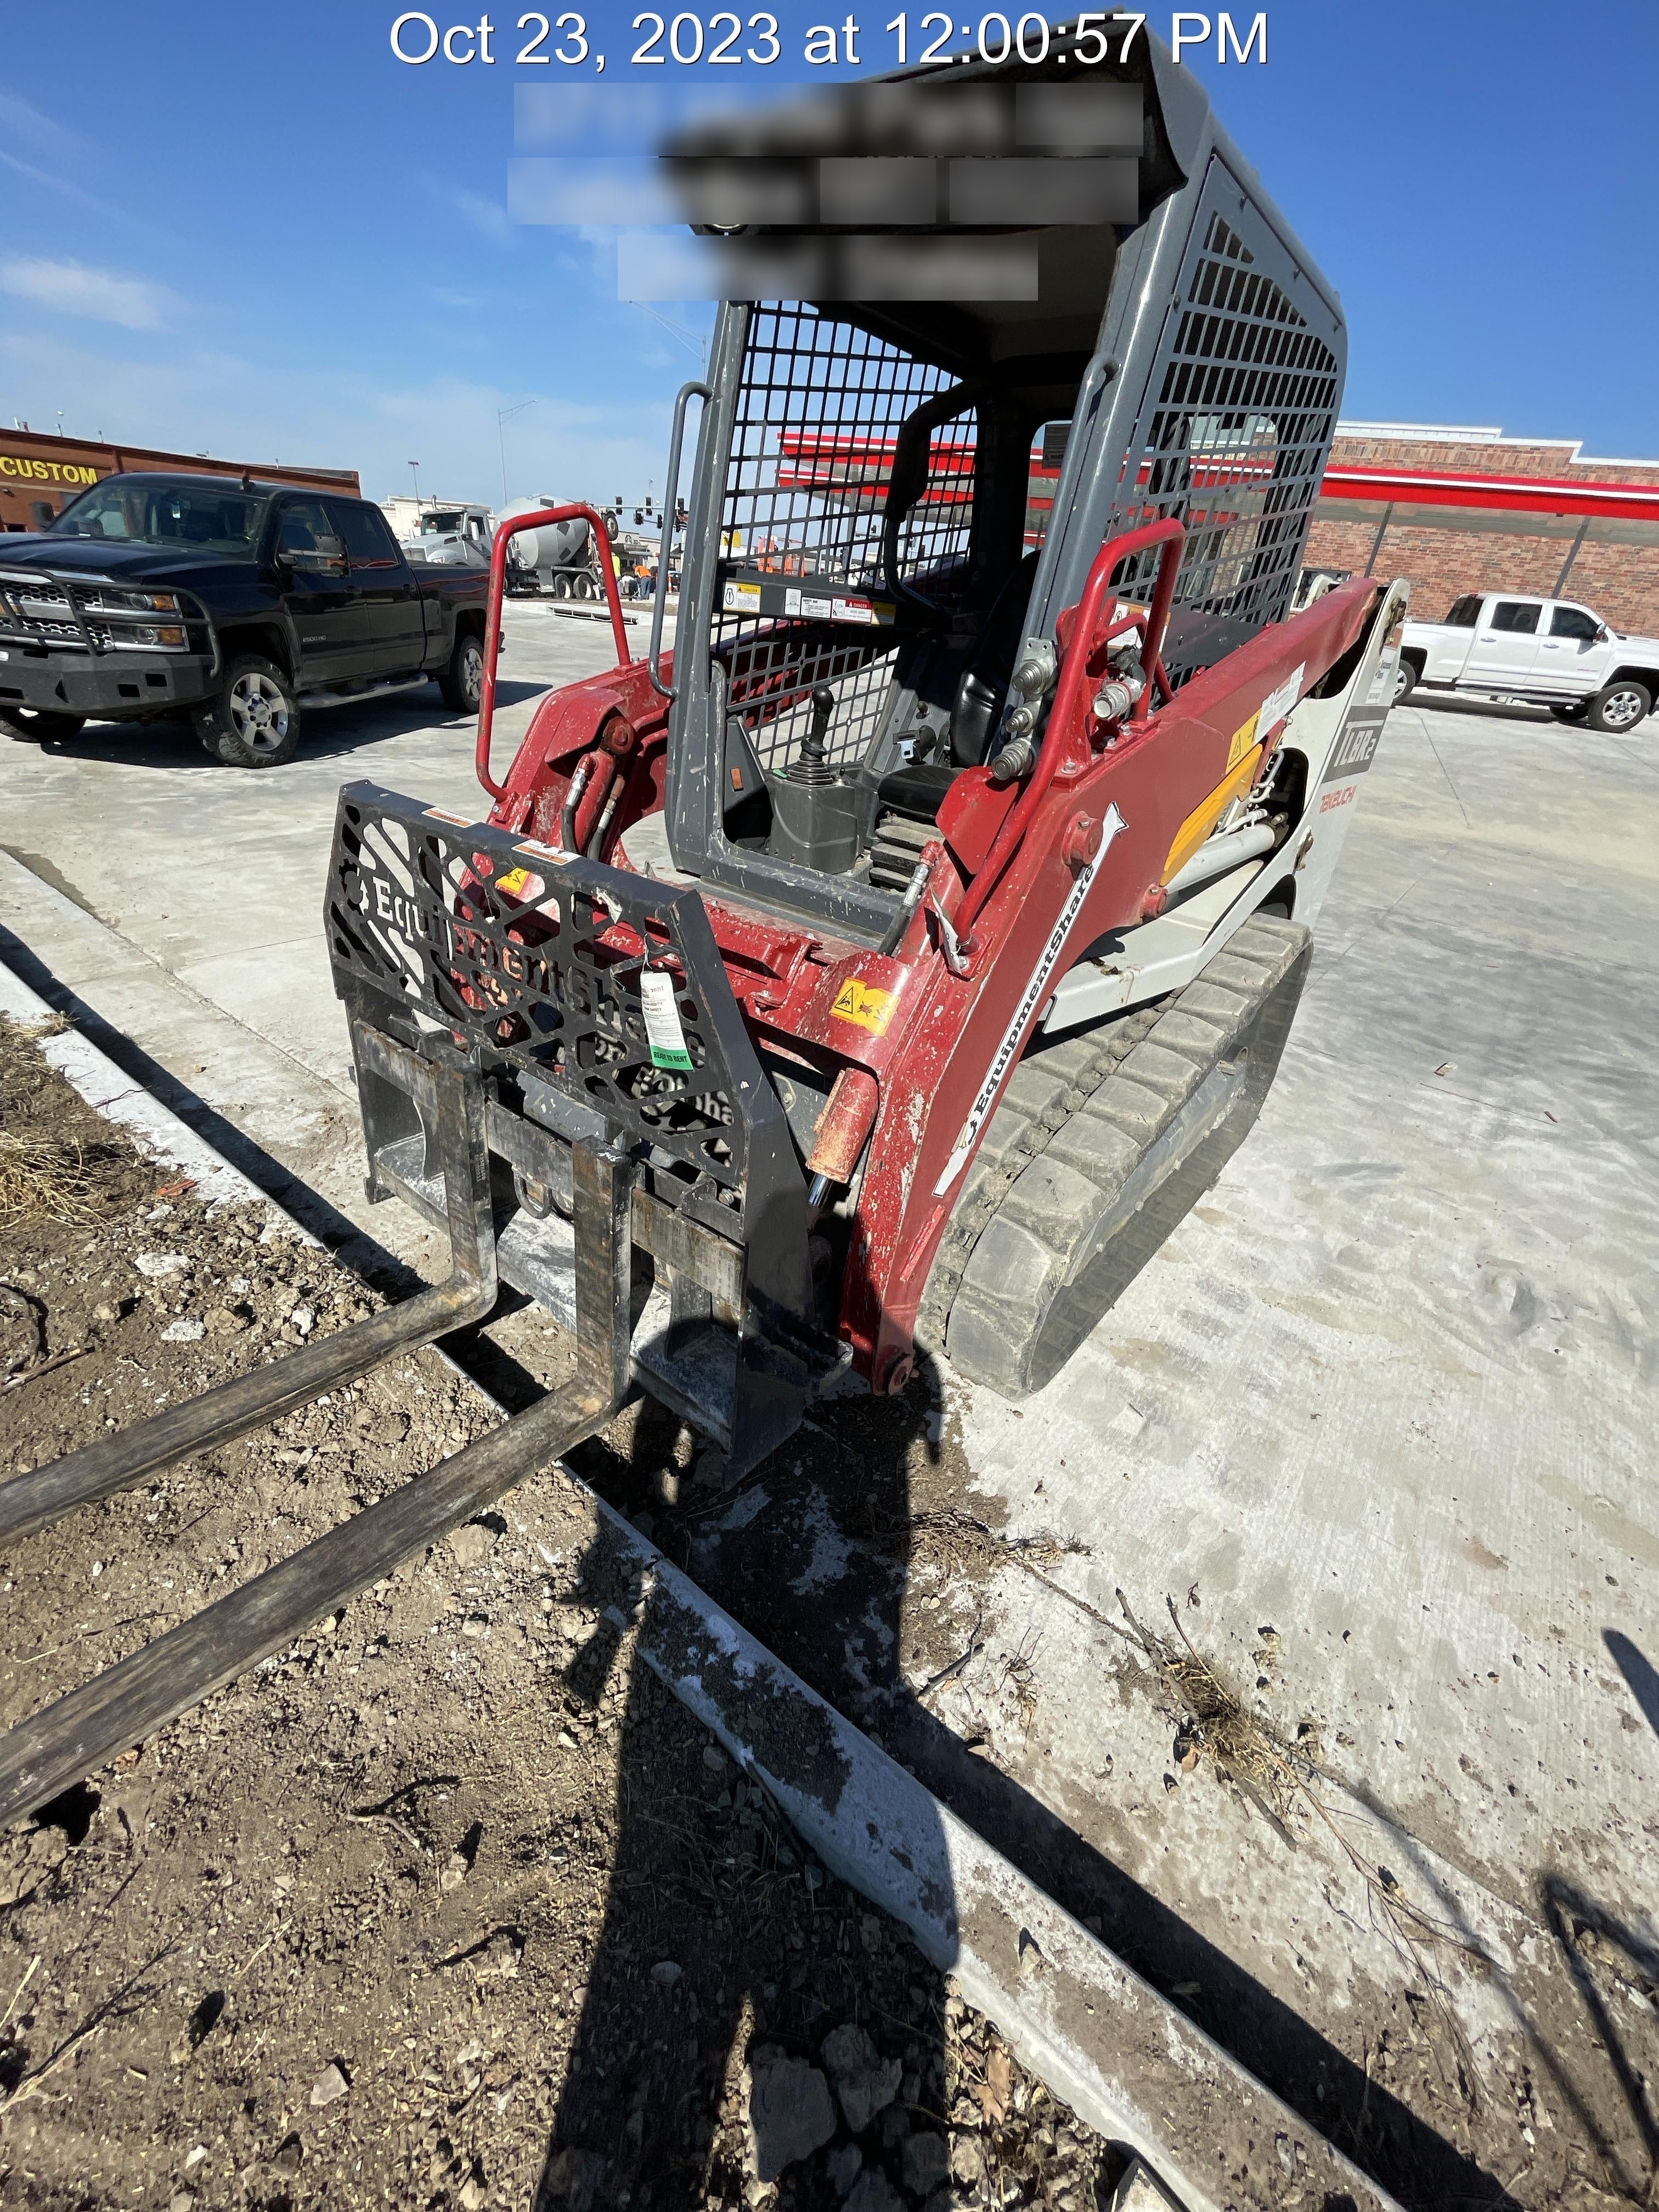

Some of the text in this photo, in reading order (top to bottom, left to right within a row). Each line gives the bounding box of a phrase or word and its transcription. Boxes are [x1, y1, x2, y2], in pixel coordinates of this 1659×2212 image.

[0, 456, 99, 485] CUSTOM
[1319, 785, 1357, 814] TAKEUCHI
[974, 865, 1094, 1116] EquipmentShare
[653, 1051, 667, 1061] READY
[674, 1055, 688, 1063] RENT
